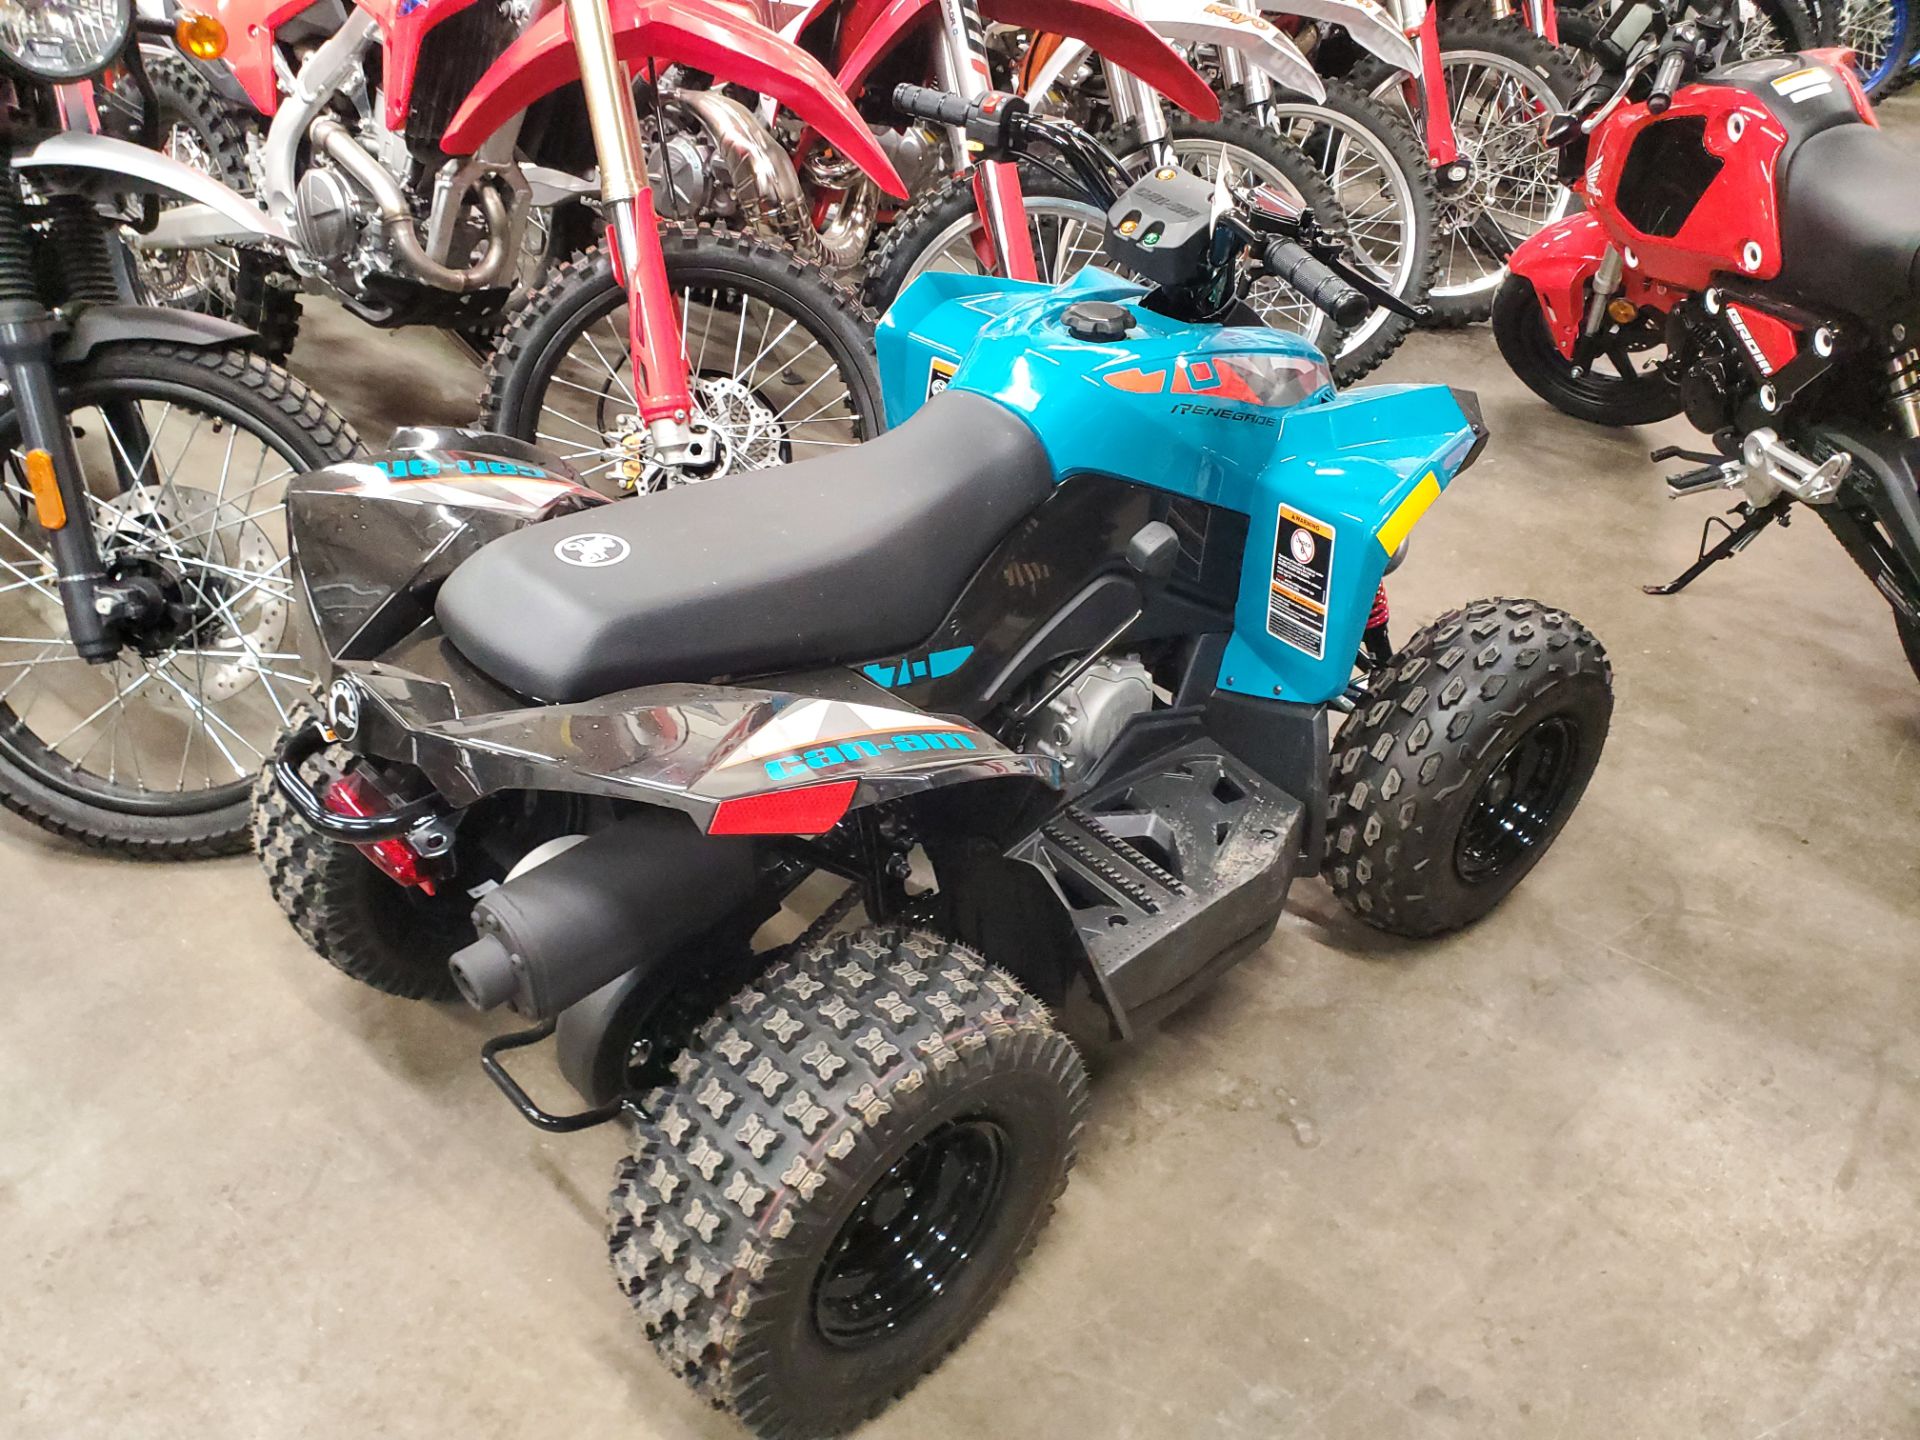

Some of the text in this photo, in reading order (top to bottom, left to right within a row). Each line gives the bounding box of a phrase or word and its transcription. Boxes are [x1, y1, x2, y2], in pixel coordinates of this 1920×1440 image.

[1726, 307, 1774, 374] GROM
[1171, 403, 1277, 427] RENEGADE
[764, 733, 977, 781] can-am
